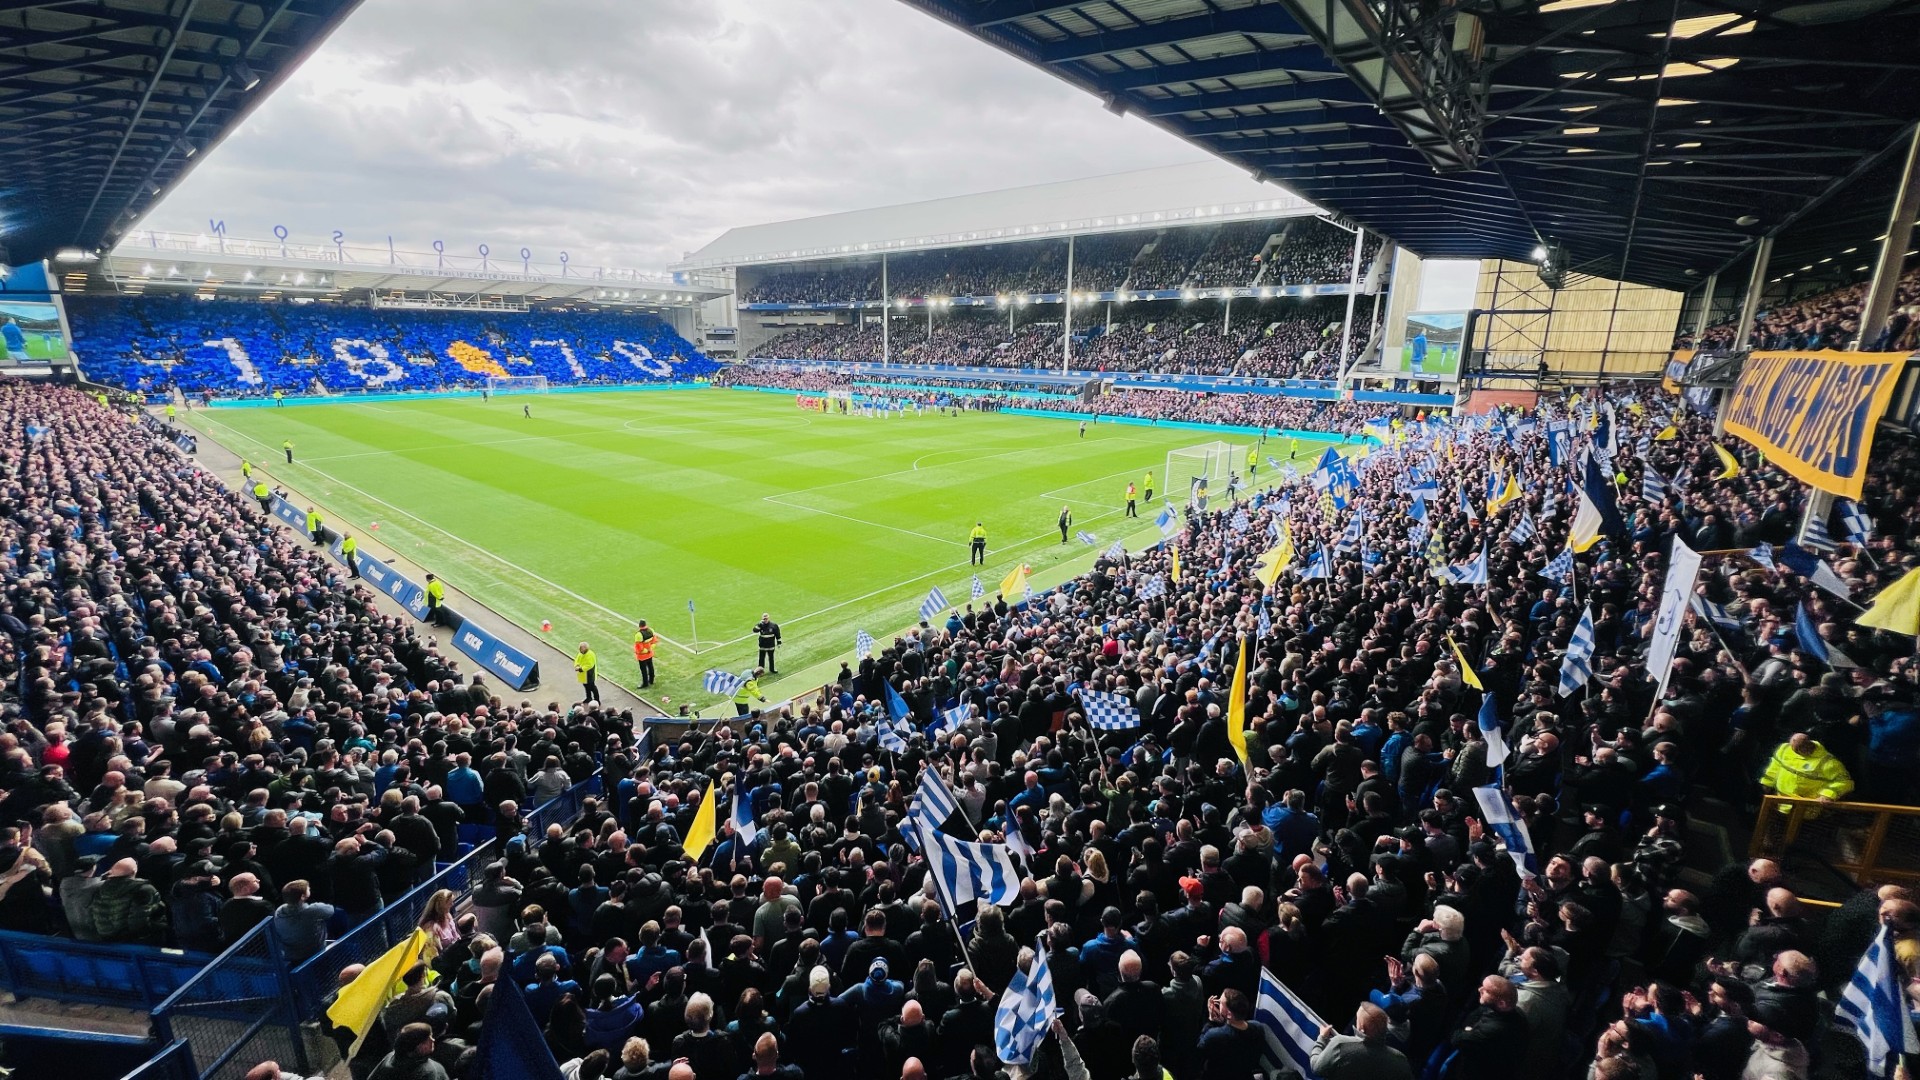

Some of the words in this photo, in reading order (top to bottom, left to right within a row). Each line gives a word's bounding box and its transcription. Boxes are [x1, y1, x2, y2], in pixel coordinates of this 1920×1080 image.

[438, 270, 464, 278] PHILIP
[468, 272, 498, 280] CARTER
[523, 275, 547, 283] STAND
